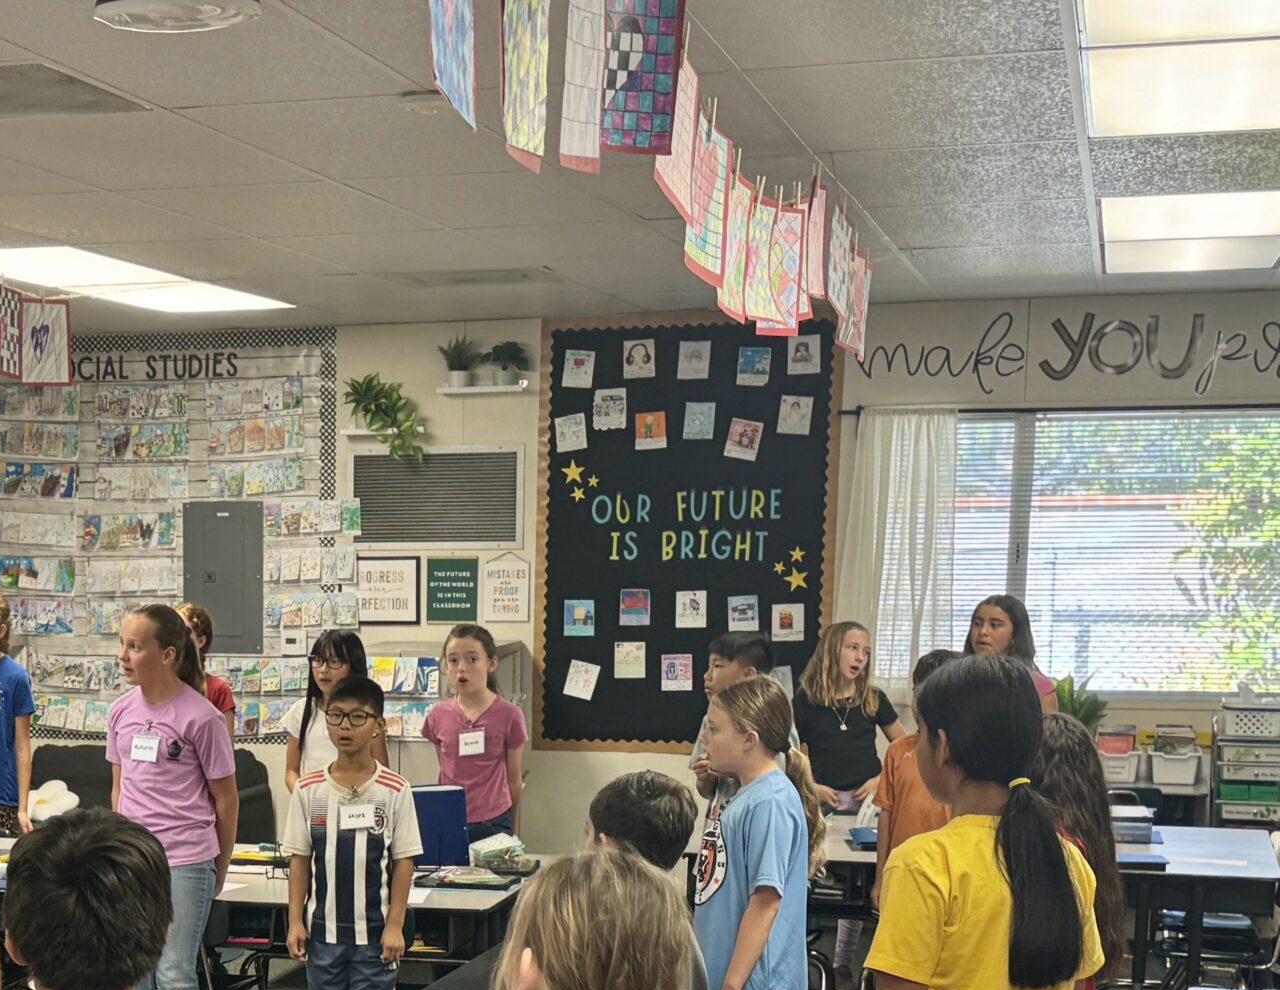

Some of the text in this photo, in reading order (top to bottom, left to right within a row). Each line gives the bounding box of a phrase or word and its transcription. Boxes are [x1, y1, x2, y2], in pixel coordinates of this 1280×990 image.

[857, 312, 1025, 394] make
[1039, 312, 1205, 381] YOU
[71, 352, 238, 381] CIAL STUDIES
[591, 489, 782, 524] OUR FUTURE
[609, 529, 768, 562] IS BRIGHT
[360, 570, 404, 584] ROGRESS
[487, 569, 526, 579] MISTAKES
[493, 587, 519, 596] PROOF
[361, 597, 408, 610] RFECTION
